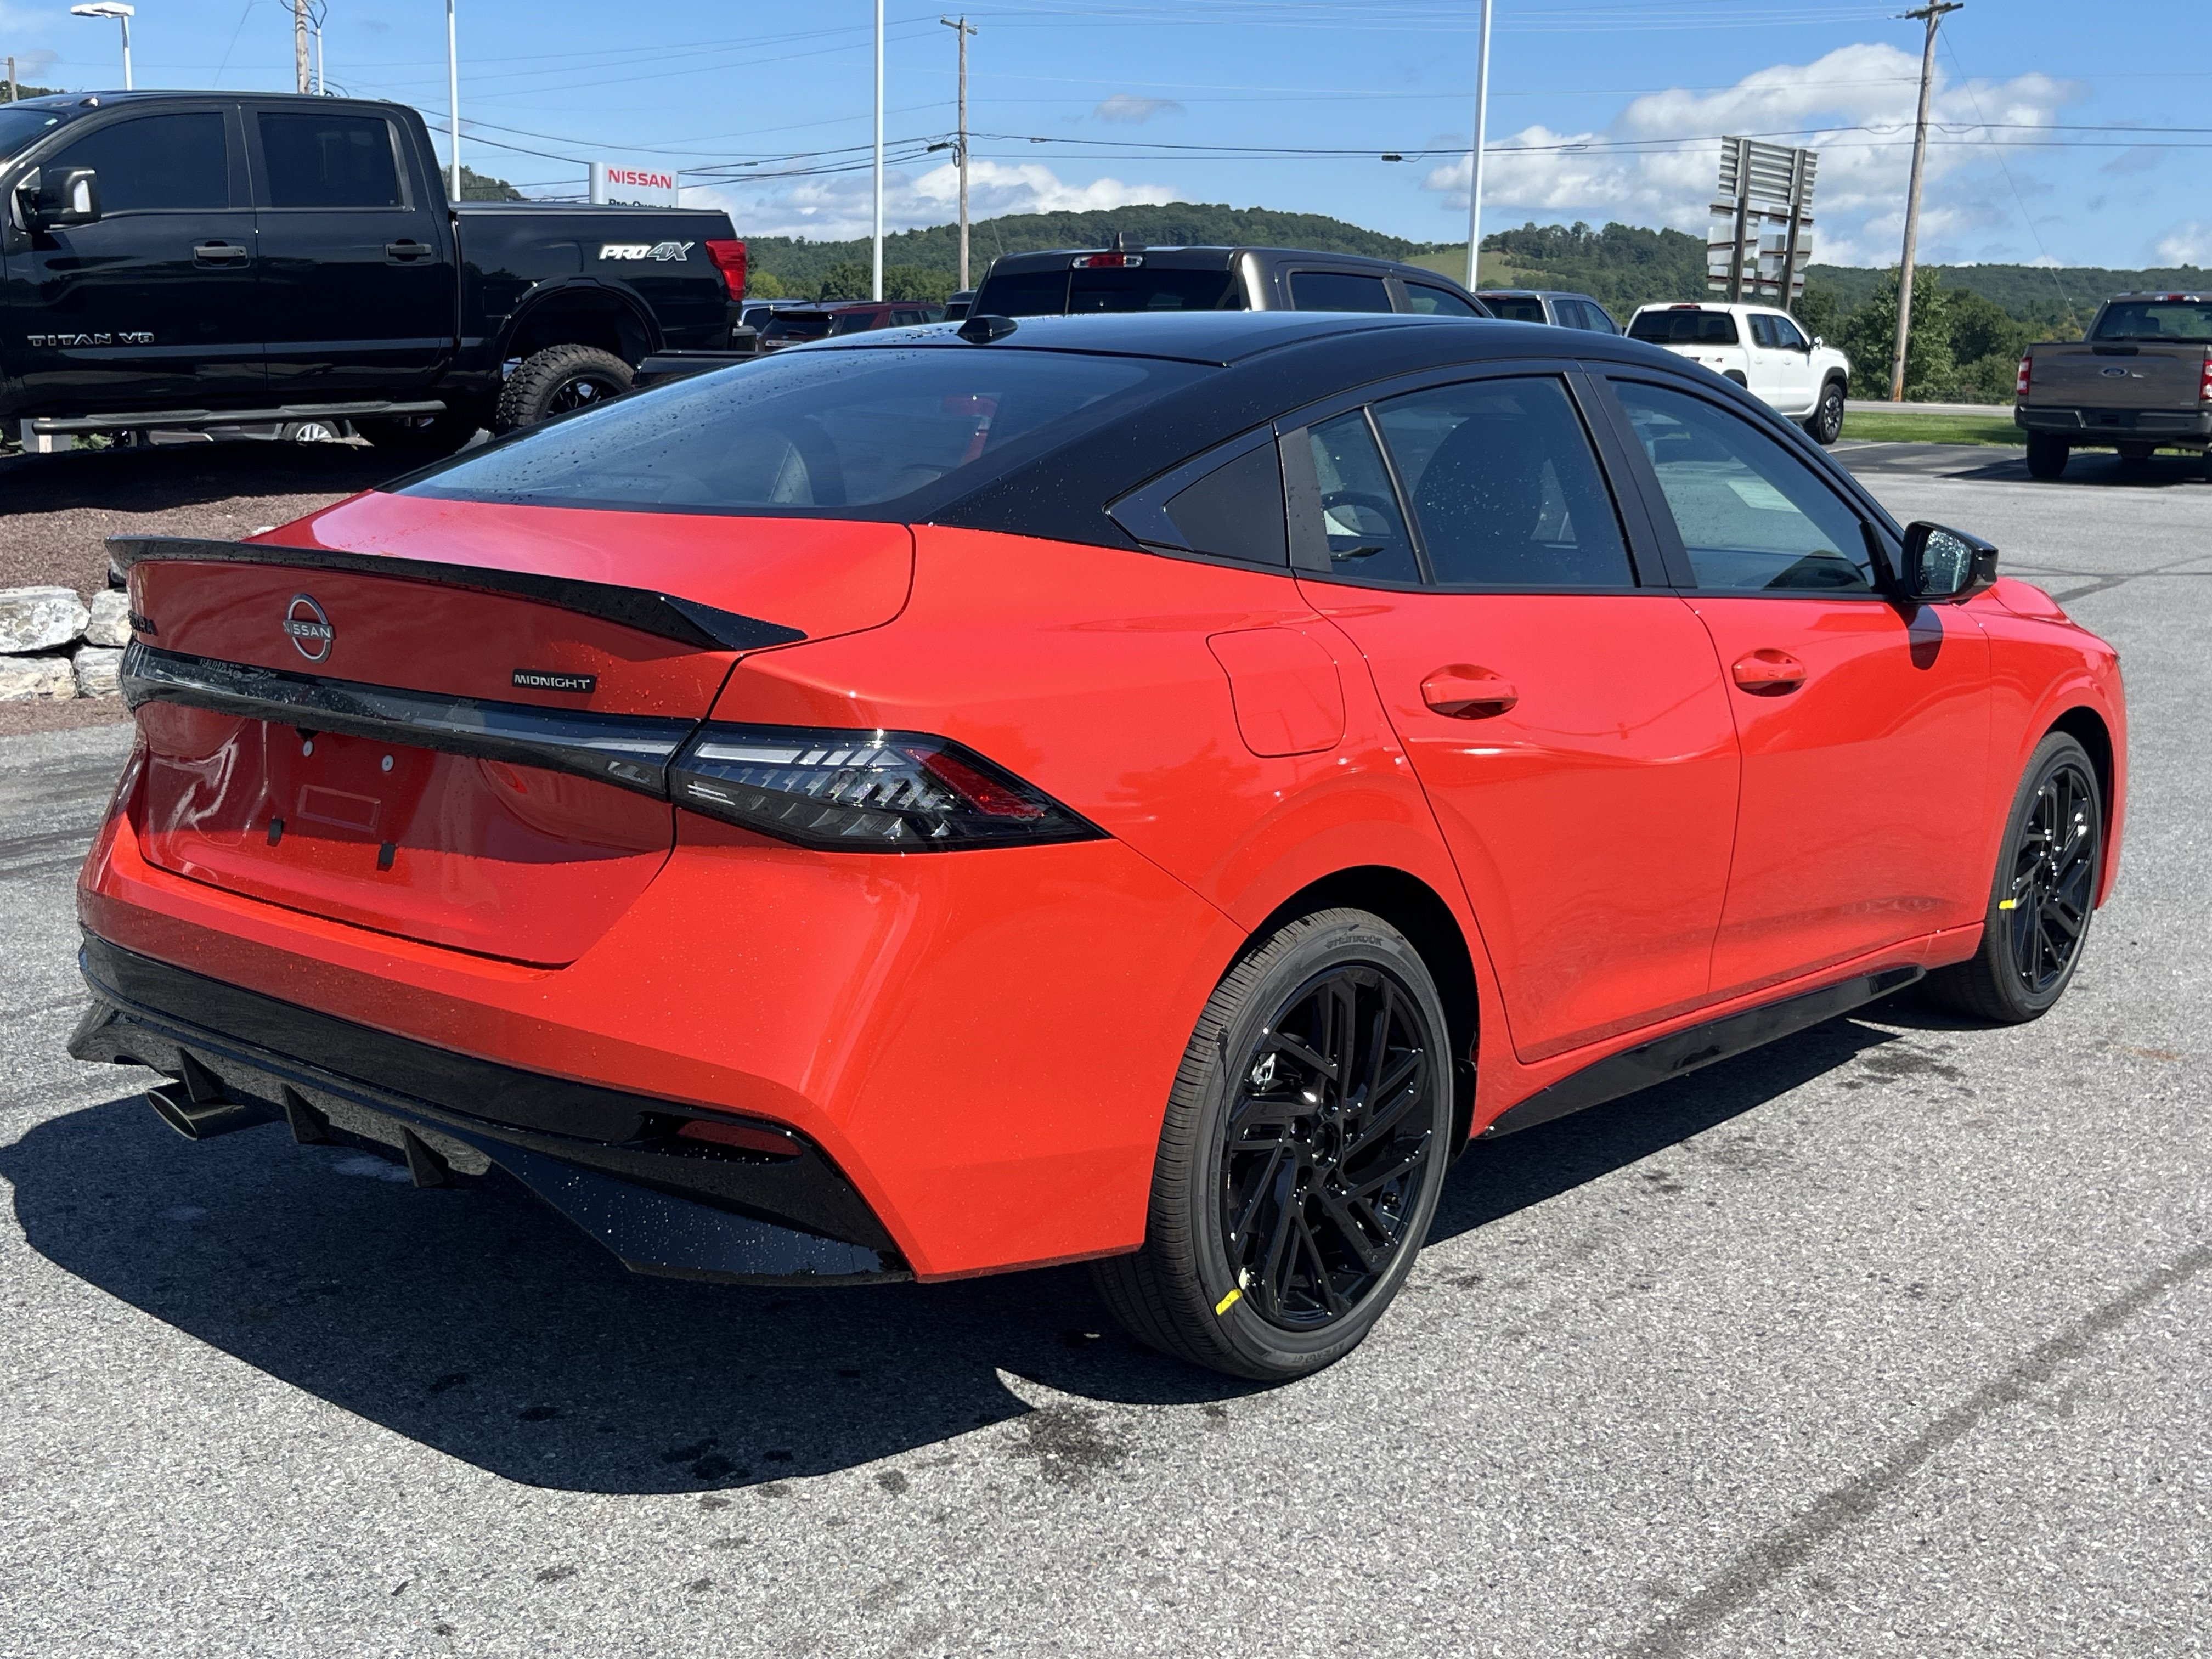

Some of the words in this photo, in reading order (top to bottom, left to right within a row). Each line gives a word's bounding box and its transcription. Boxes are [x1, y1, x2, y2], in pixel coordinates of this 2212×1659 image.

[608, 168, 672, 189] NISSAN
[27, 334, 111, 347] TITAN
[119, 332, 154, 344] V8
[283, 622, 331, 639] NISSAN
[514, 674, 590, 689] MIDNIGHT
